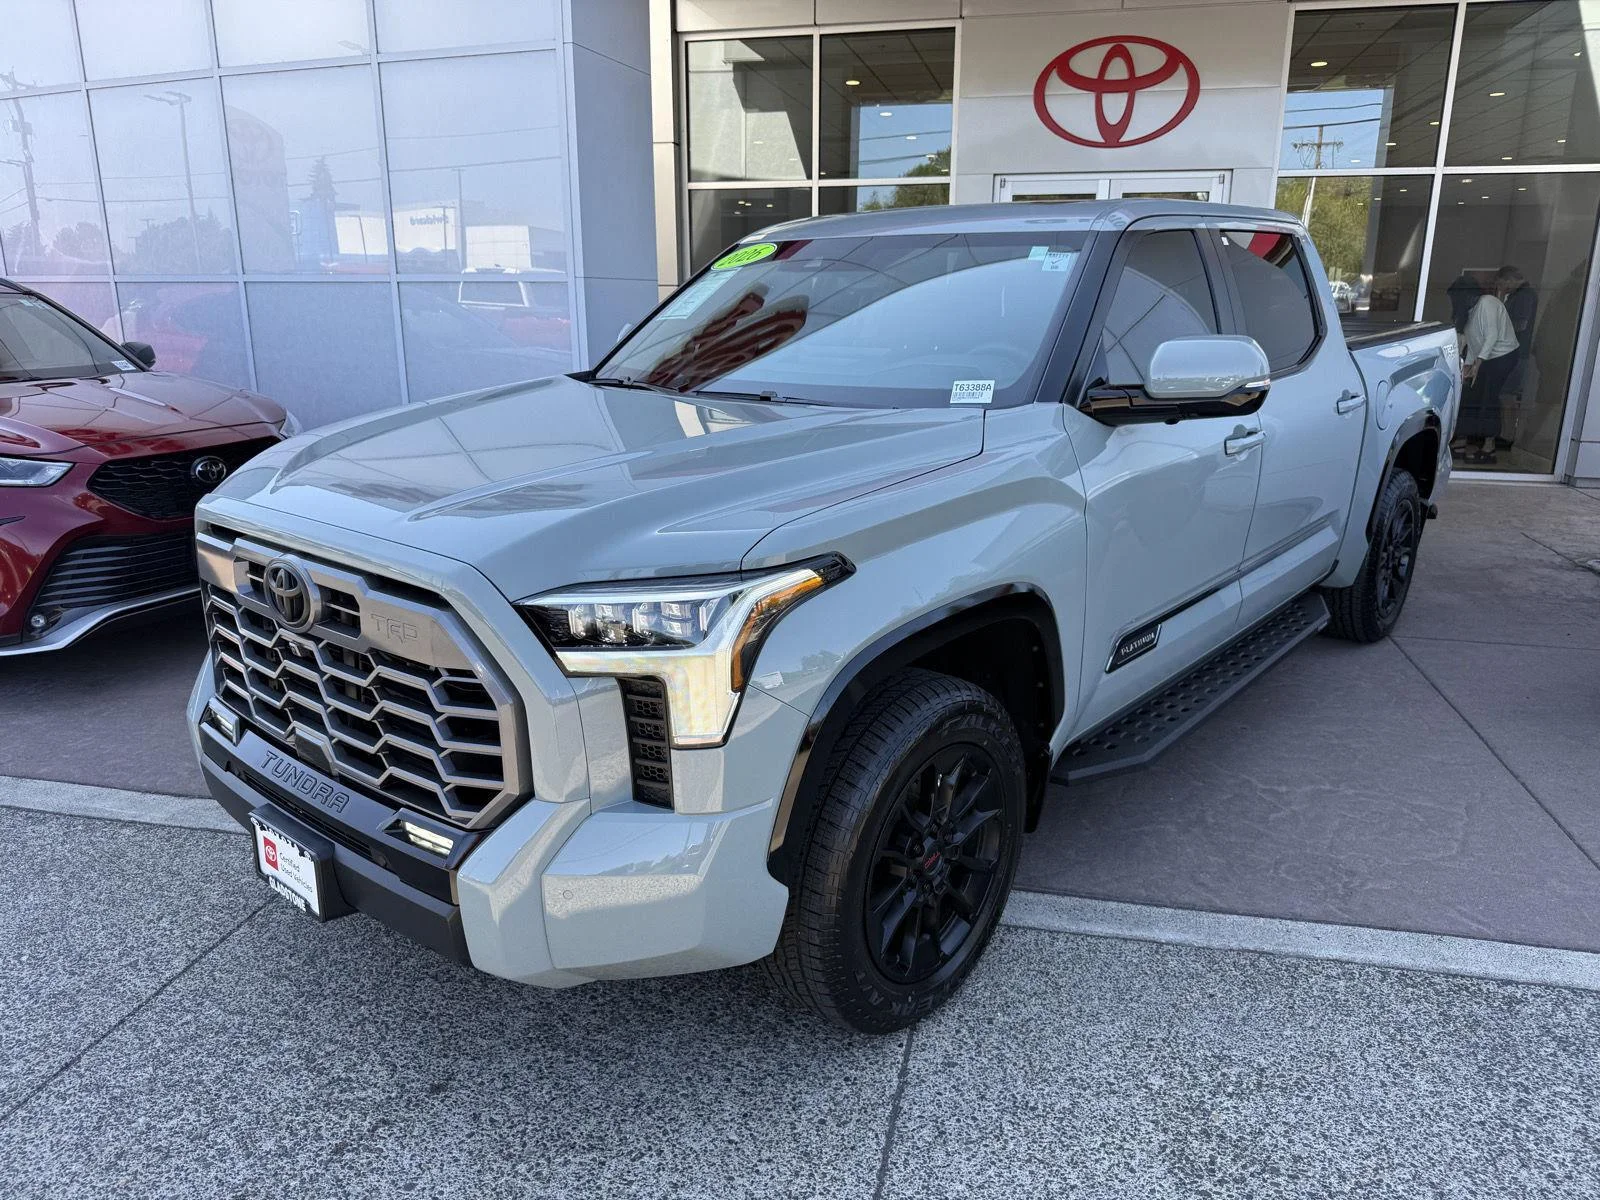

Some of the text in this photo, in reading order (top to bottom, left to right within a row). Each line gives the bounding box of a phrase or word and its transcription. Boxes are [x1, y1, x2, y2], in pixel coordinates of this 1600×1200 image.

[954, 383, 992, 392] T63388A
[370, 613, 418, 644] TRD
[1121, 632, 1155, 656] PLATINUM
[260, 750, 350, 814] TUNDRA
[279, 852, 301, 872] Certified
[293, 872, 313, 893] Vehicles
